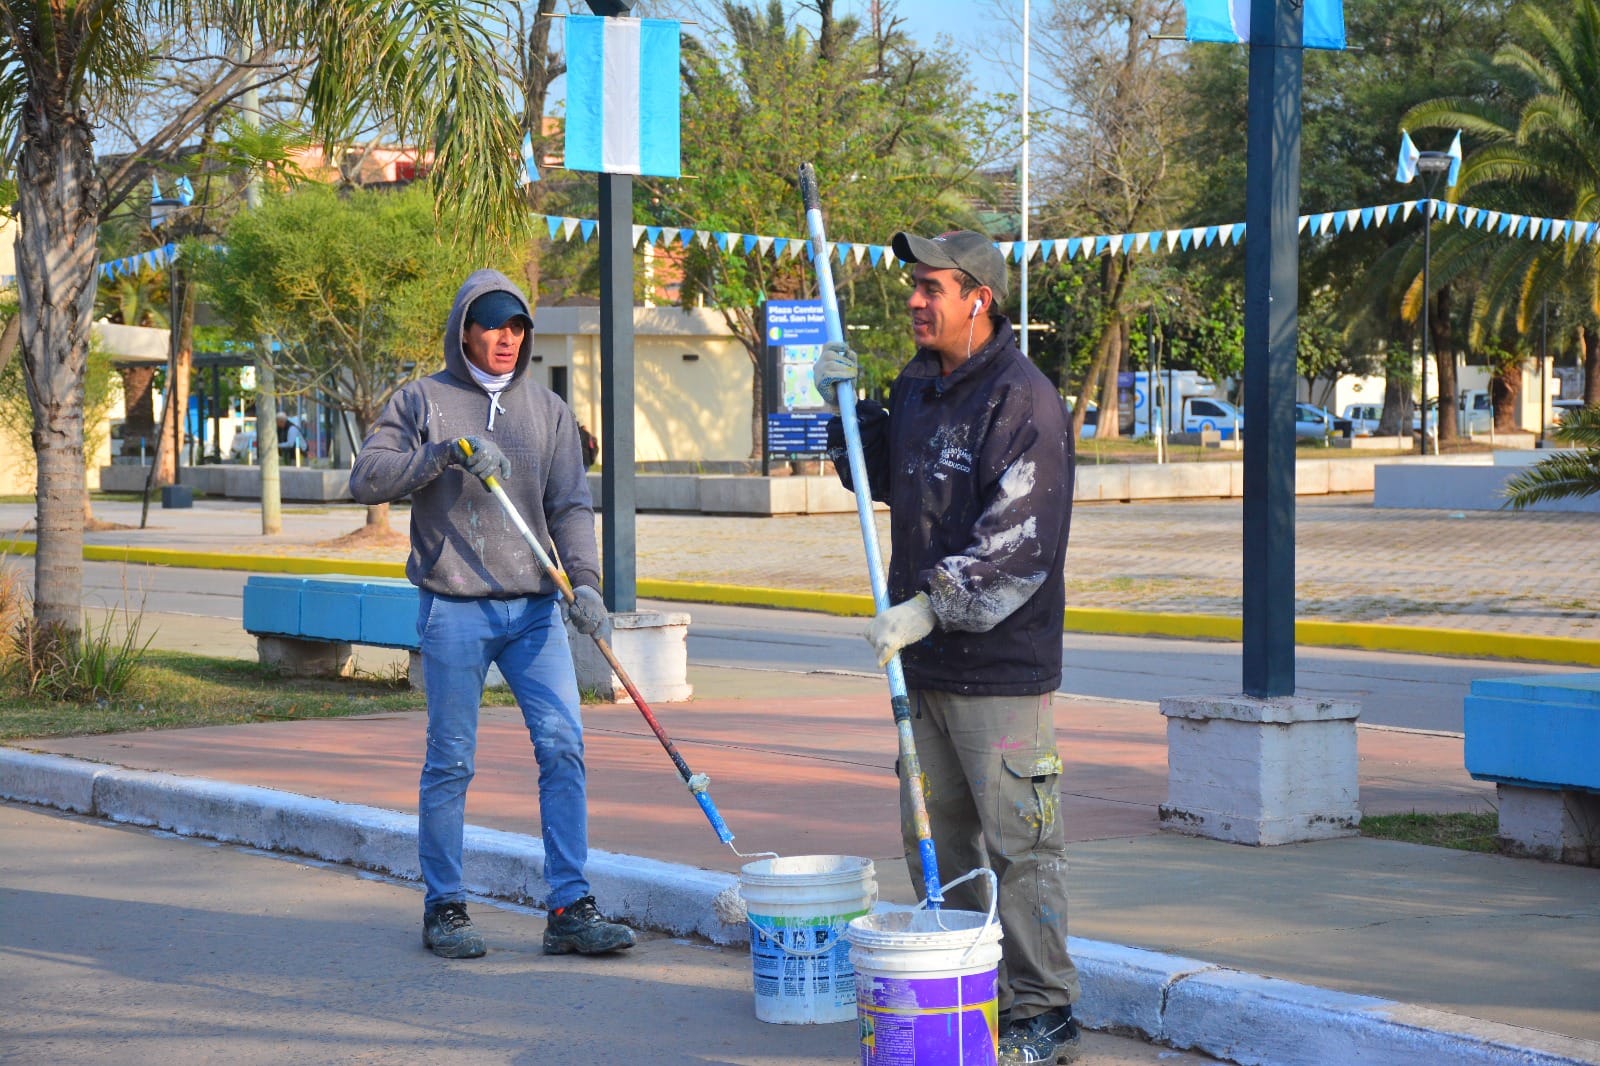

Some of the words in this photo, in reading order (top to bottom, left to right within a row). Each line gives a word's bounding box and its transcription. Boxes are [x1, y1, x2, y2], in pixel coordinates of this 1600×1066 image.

[768, 306, 792, 314] Plaza
[793, 306, 824, 314] Central
[769, 315, 788, 323] Gral.
[789, 315, 806, 323] San
